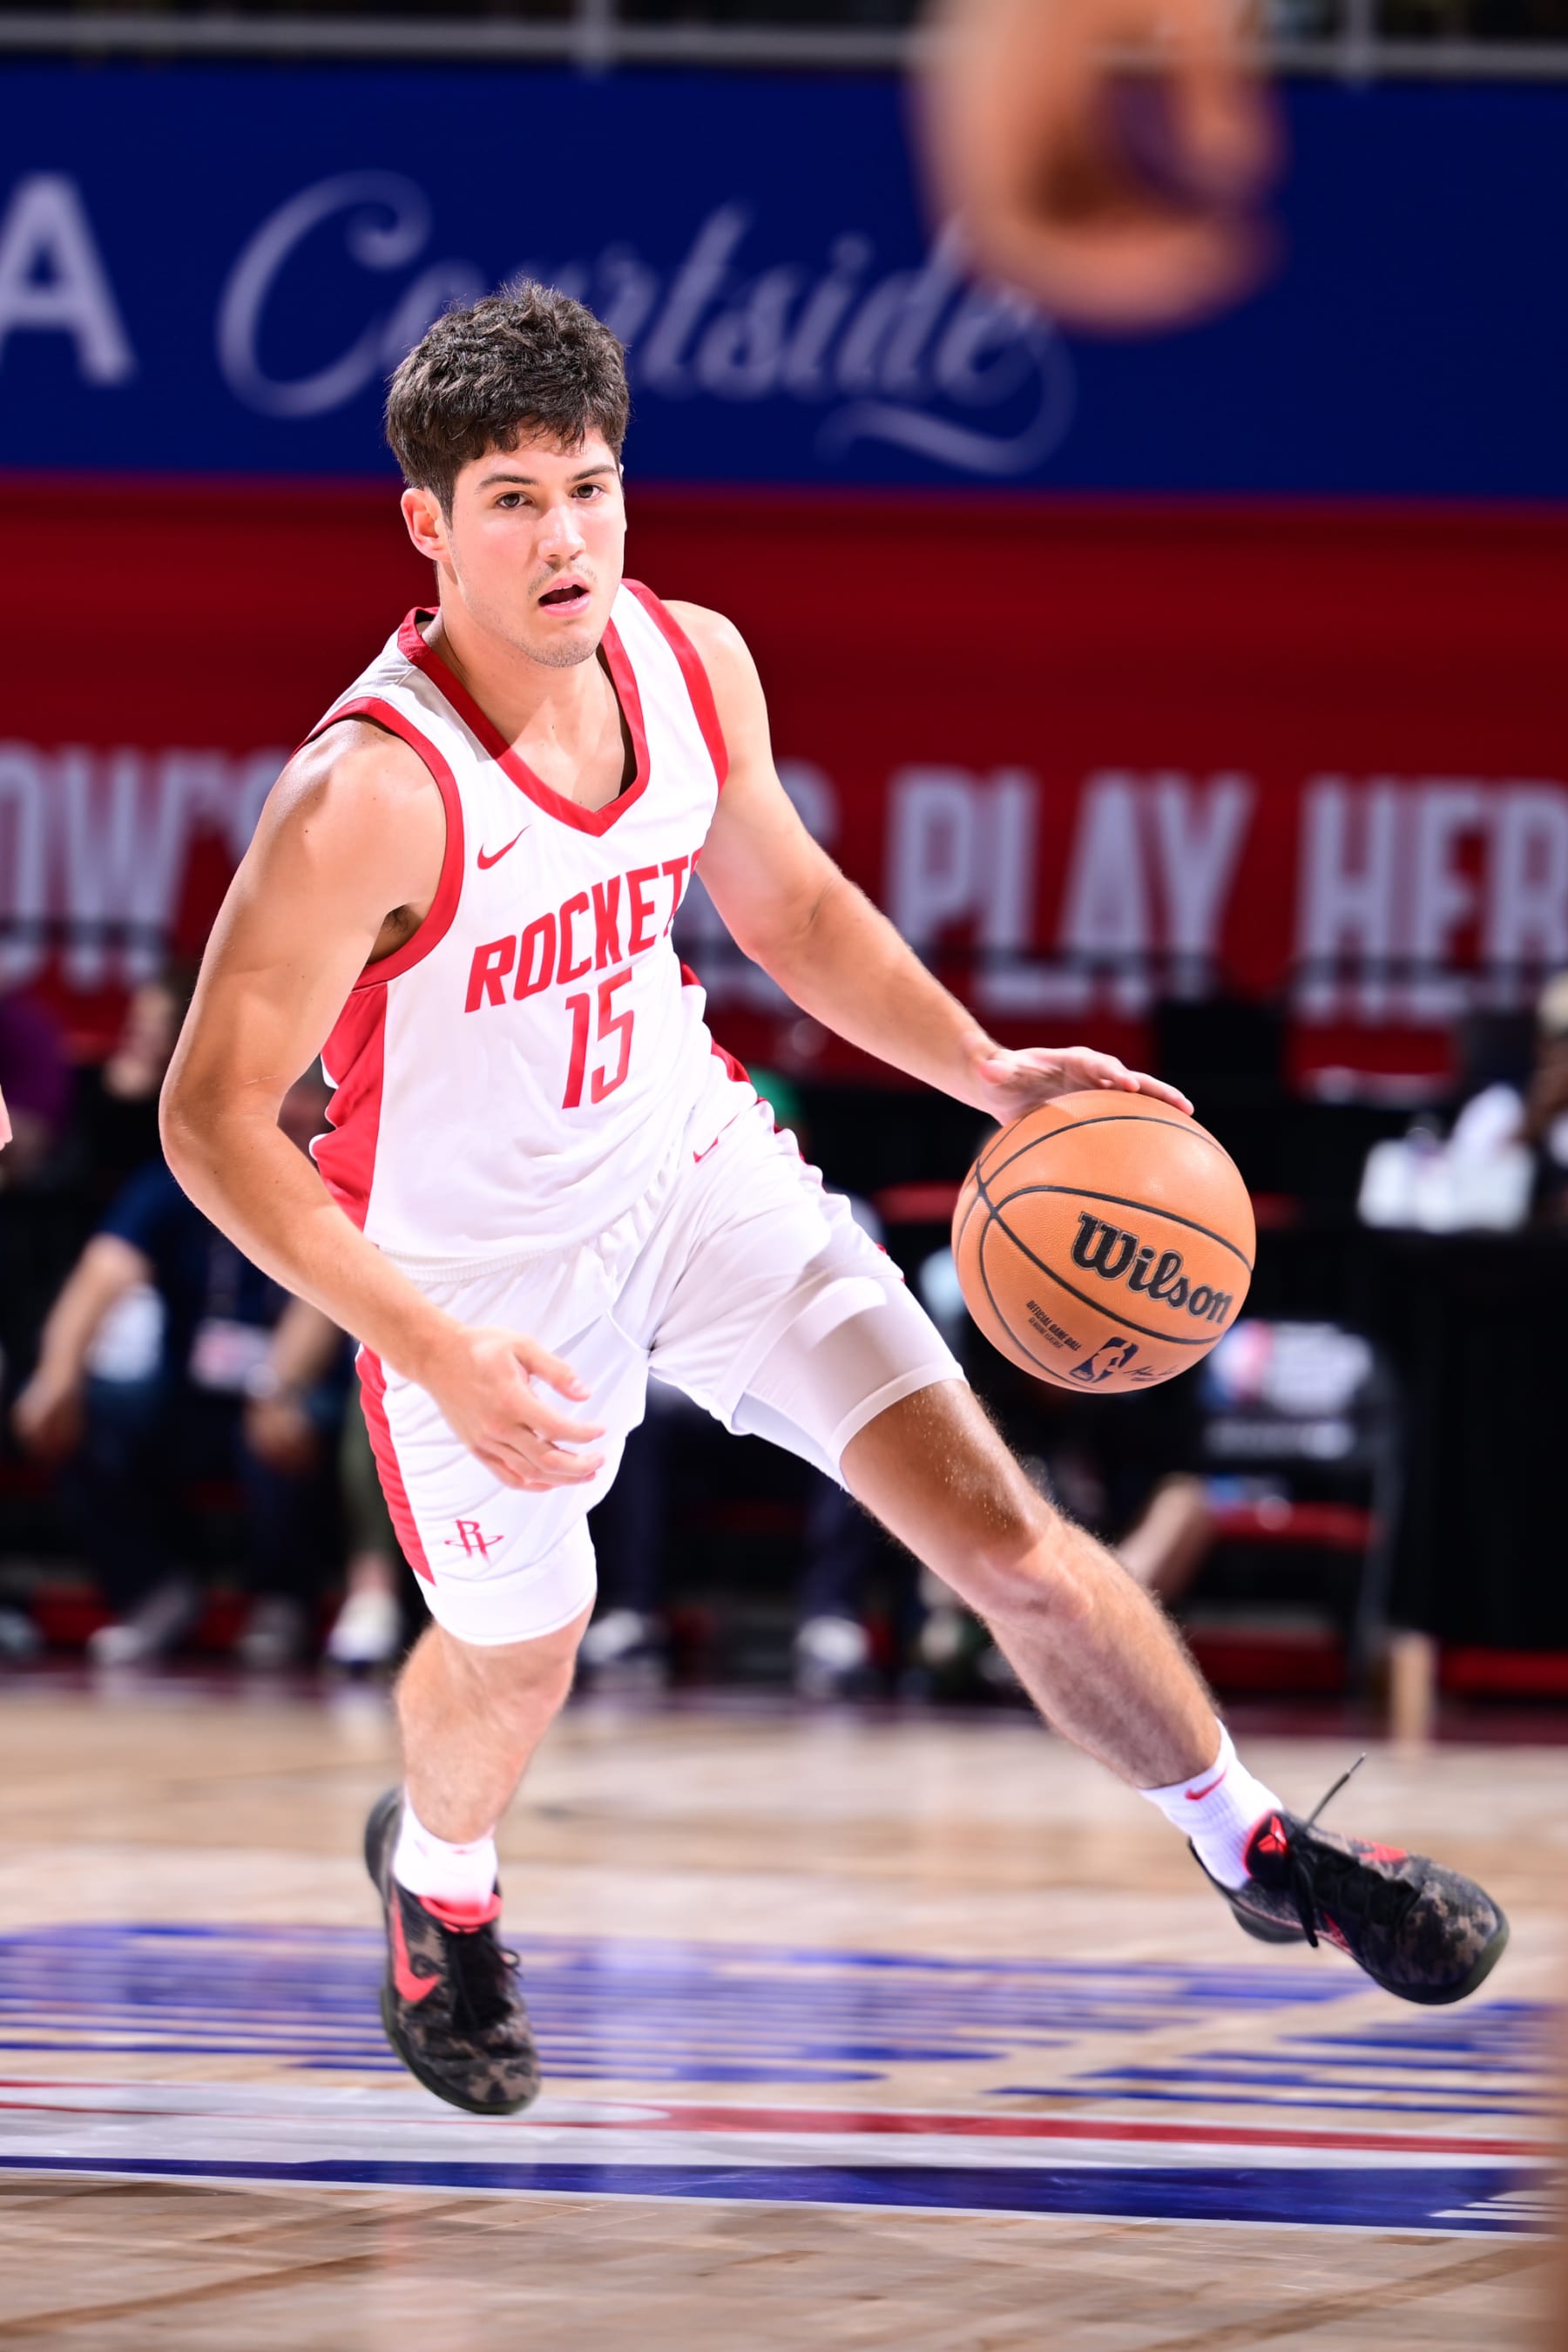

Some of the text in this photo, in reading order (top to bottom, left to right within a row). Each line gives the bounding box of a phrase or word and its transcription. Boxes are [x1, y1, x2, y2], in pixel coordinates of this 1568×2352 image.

[464, 848, 703, 1013] ROCKET
[885, 764, 1254, 1017] PLAY
[1296, 775, 1568, 1024] HER
[562, 967, 634, 1109] 15
[1026, 1300, 1052, 1327] OFFICIAL
[1064, 1336, 1082, 1351] BALL
[1071, 1211, 1233, 1325] Wilson
